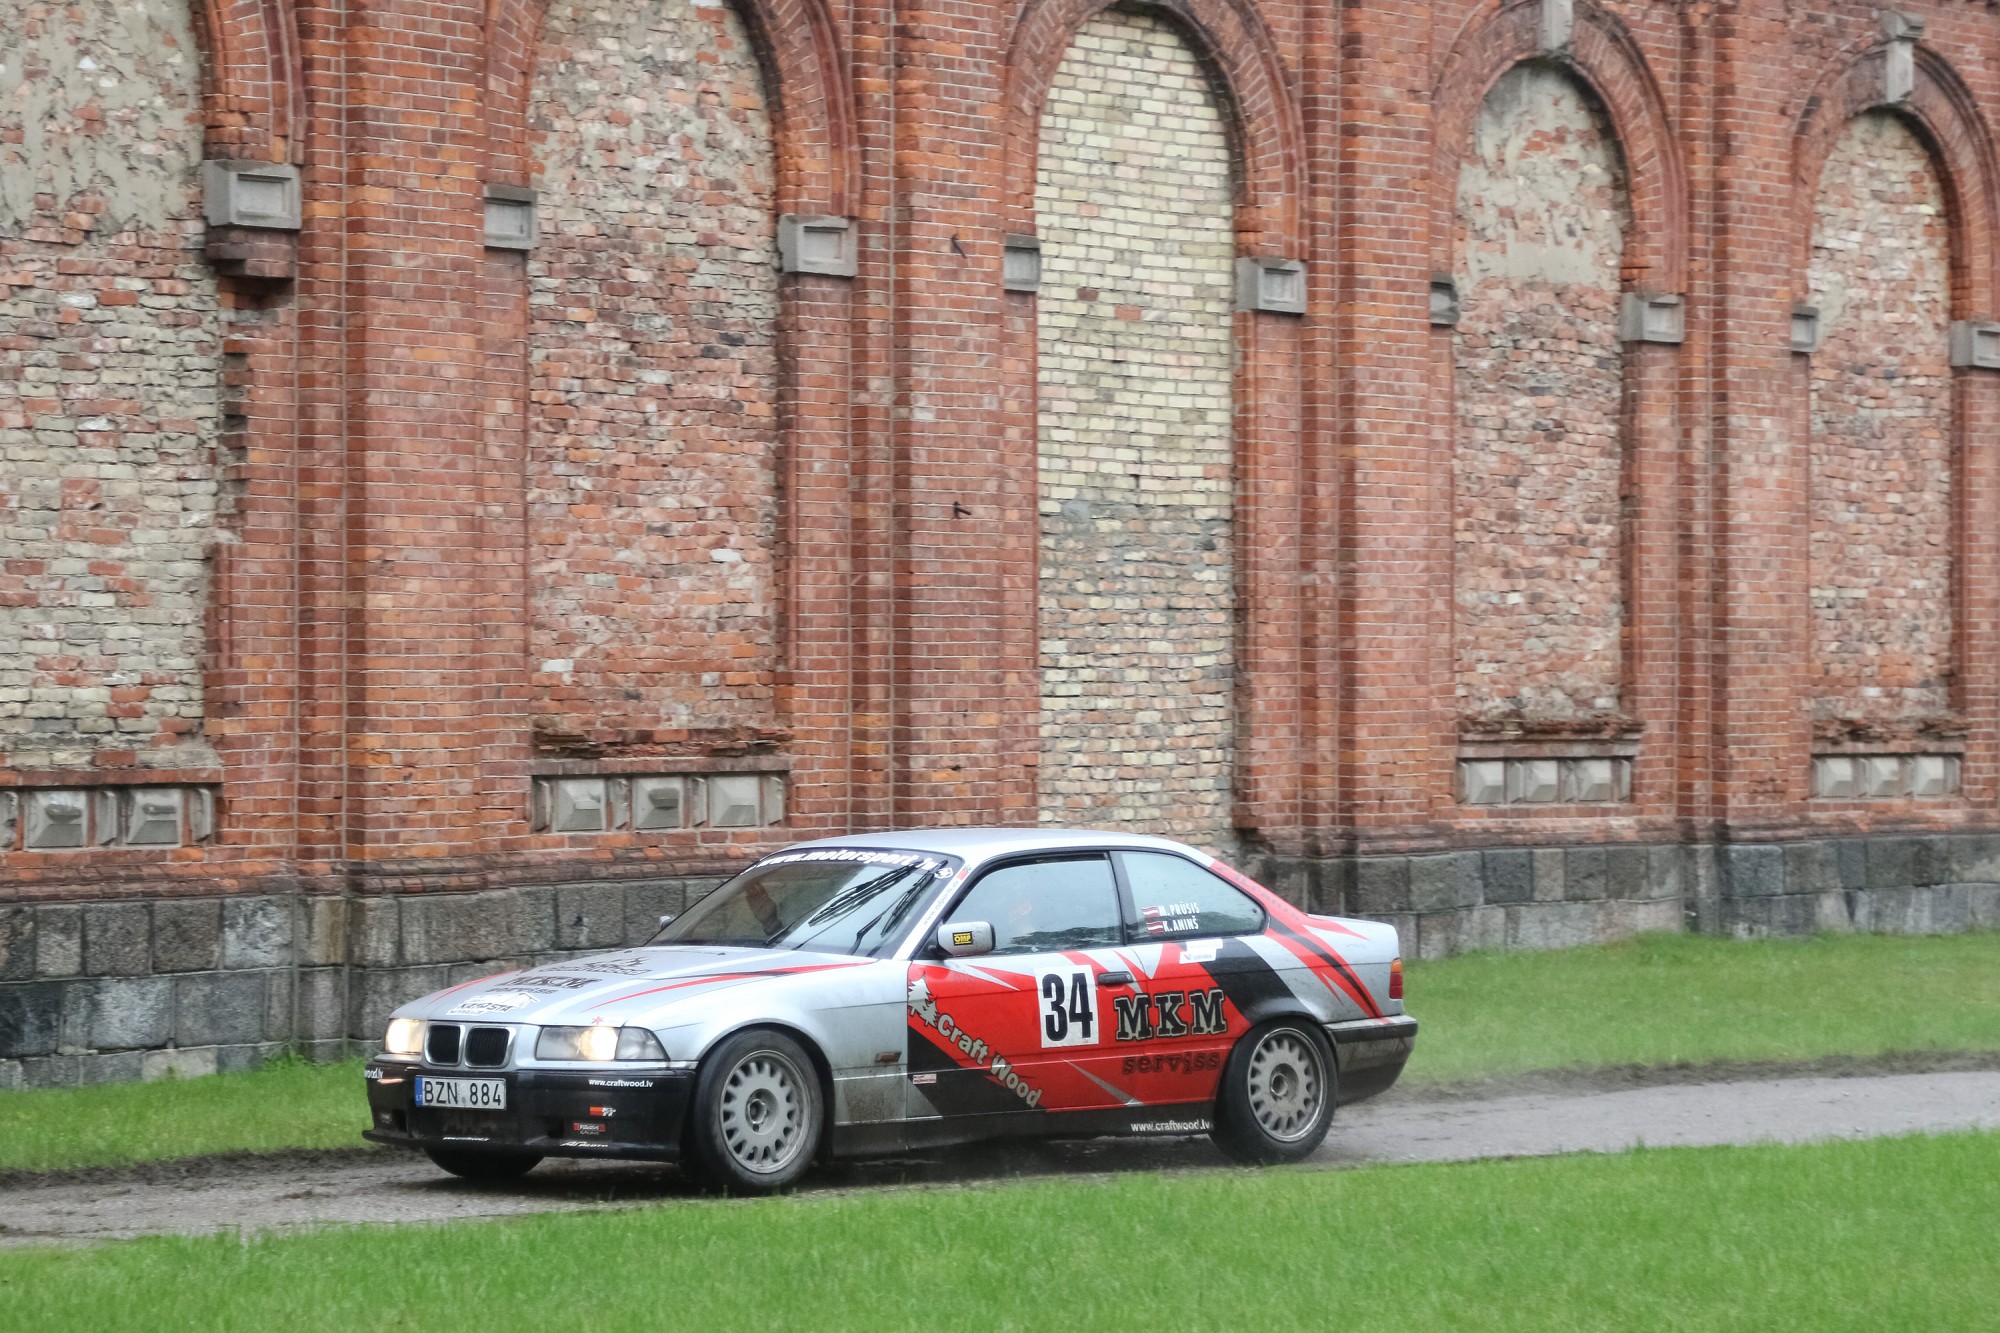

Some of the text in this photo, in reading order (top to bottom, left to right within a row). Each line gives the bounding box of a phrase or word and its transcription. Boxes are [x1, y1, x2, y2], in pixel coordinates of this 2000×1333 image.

[1042, 973, 1093, 1041] 34
[1114, 988, 1228, 1041] MKM
[937, 1013, 1043, 1109] Craft Wood
[1122, 1051, 1221, 1074] serviss
[424, 1080, 502, 1106] BZN 884
[588, 1079, 653, 1088] www.craftwood.lv
[1130, 1119, 1210, 1132] www.craftwood.lv
